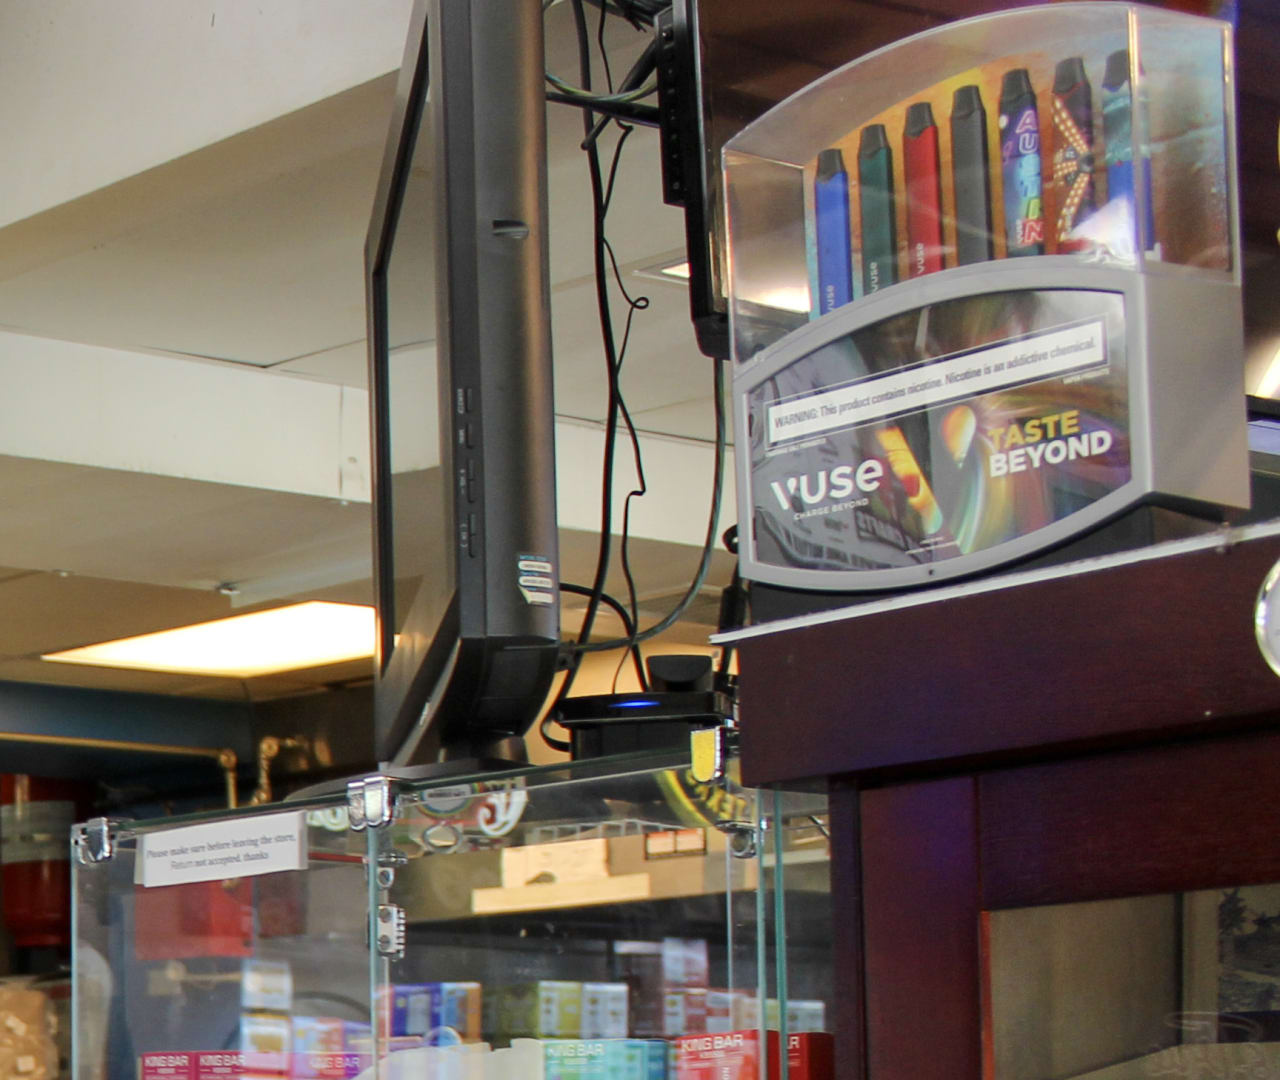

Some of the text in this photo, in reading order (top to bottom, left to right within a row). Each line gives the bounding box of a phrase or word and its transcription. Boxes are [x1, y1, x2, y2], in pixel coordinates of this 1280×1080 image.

[820, 405, 837, 417] This
[839, 397, 870, 416] product
[872, 387, 905, 404] contains
[945, 368, 981, 385] Nicotine
[984, 364, 991, 374] is
[993, 362, 1005, 373] an
[1007, 351, 1048, 369] addictive
[989, 410, 1080, 451] TASTE
[990, 430, 1113, 477] BEYOND
[794, 498, 869, 520] CHARGE BEYOND
[261, 835, 272, 844] the
[577, 1044, 605, 1056] BAR
[682, 1034, 743, 1052] KING BAR
[145, 1055, 188, 1067] KING BAR
[223, 1055, 245, 1066] BAR
[335, 1057, 361, 1068] BAR
